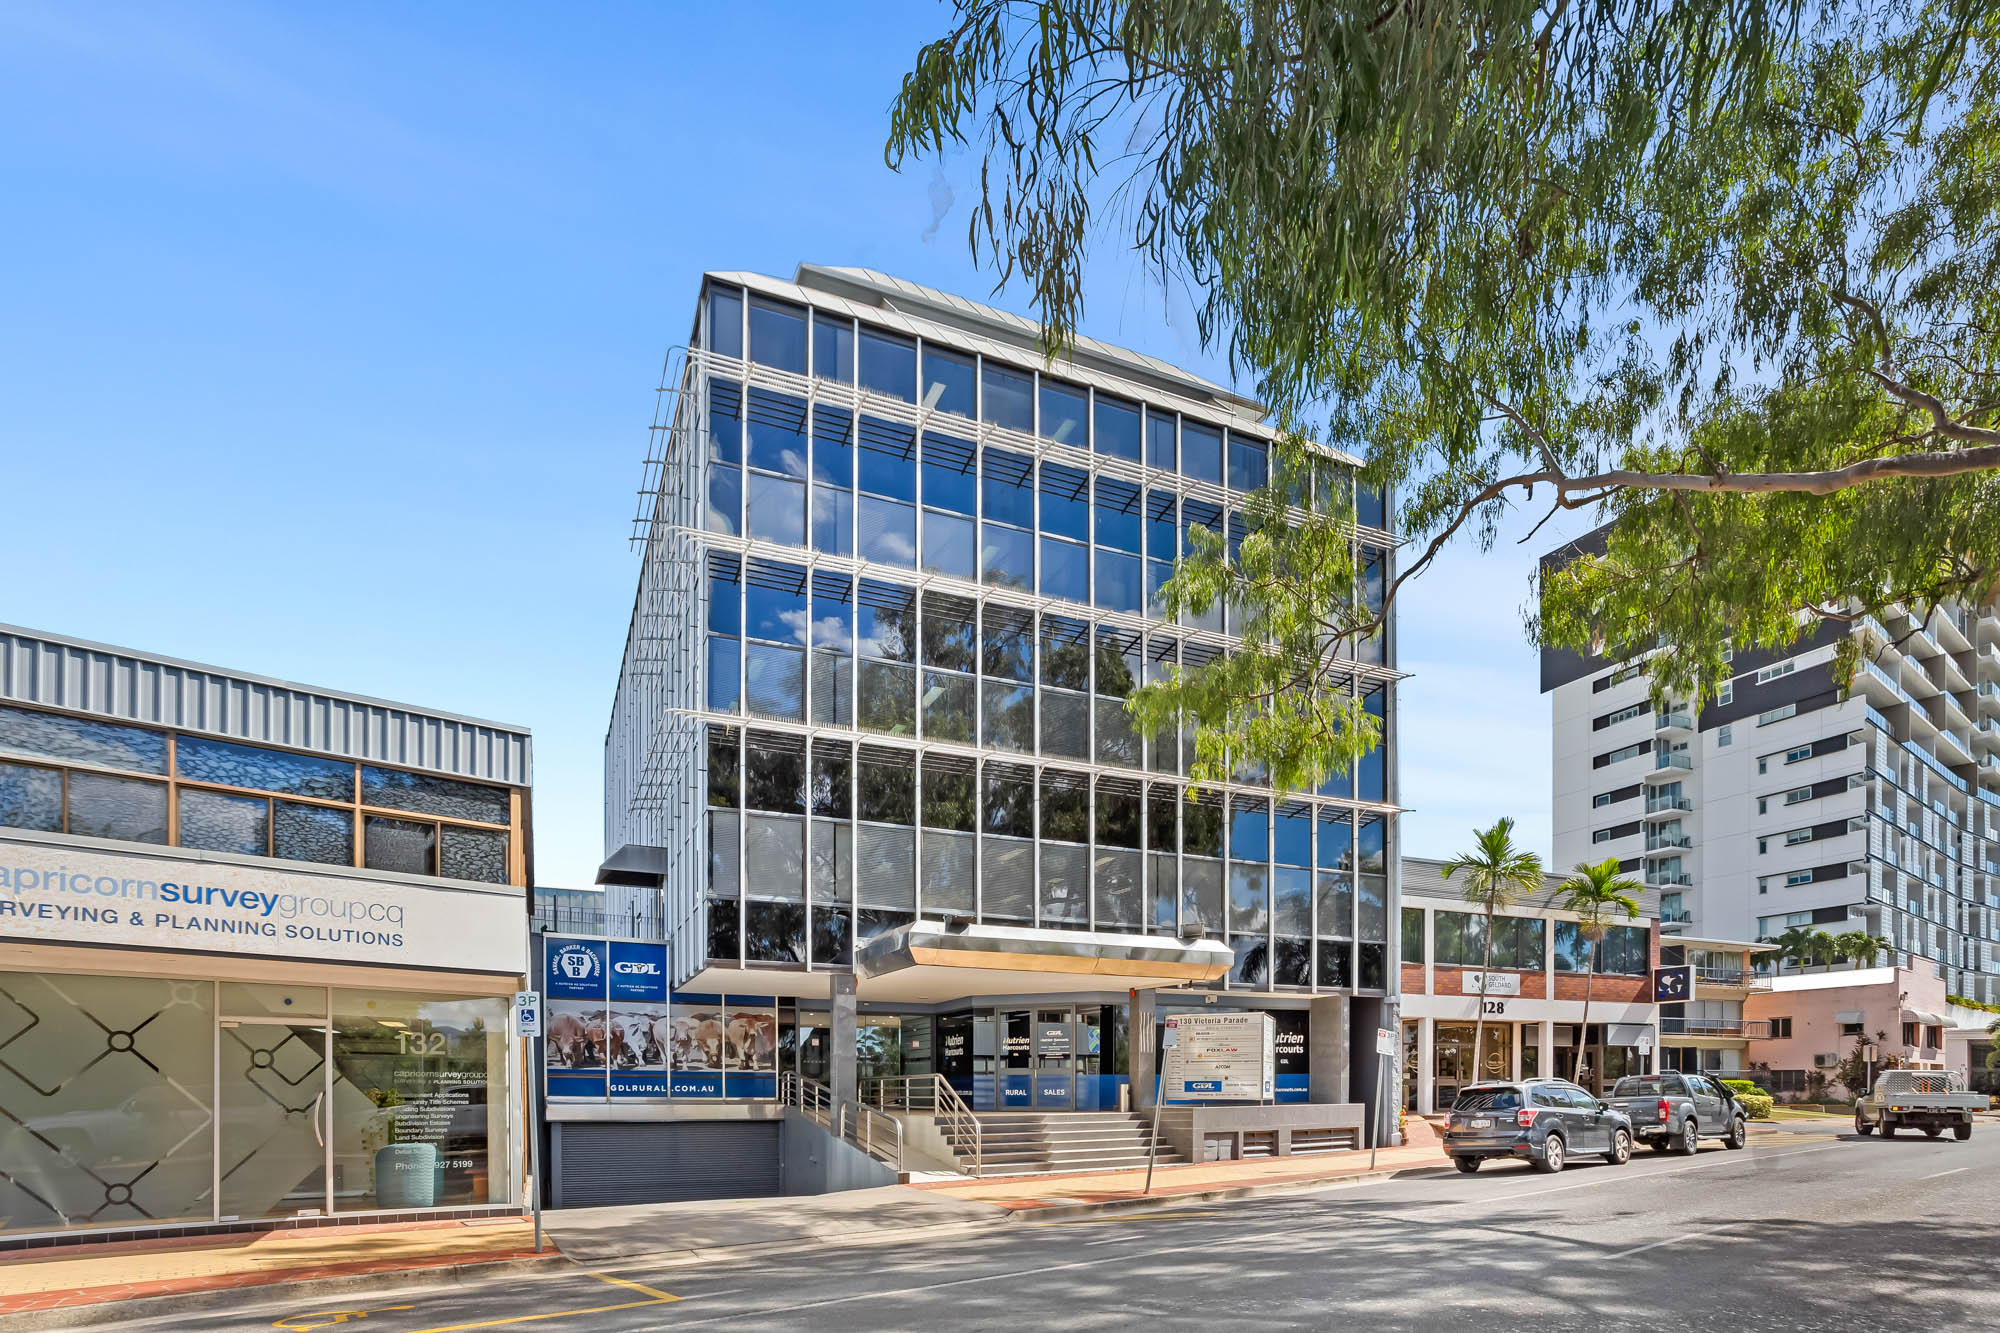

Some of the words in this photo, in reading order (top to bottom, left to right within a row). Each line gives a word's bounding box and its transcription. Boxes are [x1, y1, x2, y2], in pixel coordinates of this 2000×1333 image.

[0, 900, 119, 925] RVEYING
[129, 911, 145, 926] &
[155, 913, 277, 937] PLANNING
[285, 924, 404, 947] SOLUTIONS
[568, 955, 585, 967] SB
[572, 966, 581, 977] B
[614, 961, 661, 975] GDL
[518, 995, 537, 1007] 3P
[1483, 1001, 1505, 1014] 128
[1194, 1017, 1221, 1025] Victoria
[394, 1031, 446, 1055] 132
[1275, 1045, 1304, 1054] rcourts
[452, 1160, 473, 1169] 5199
